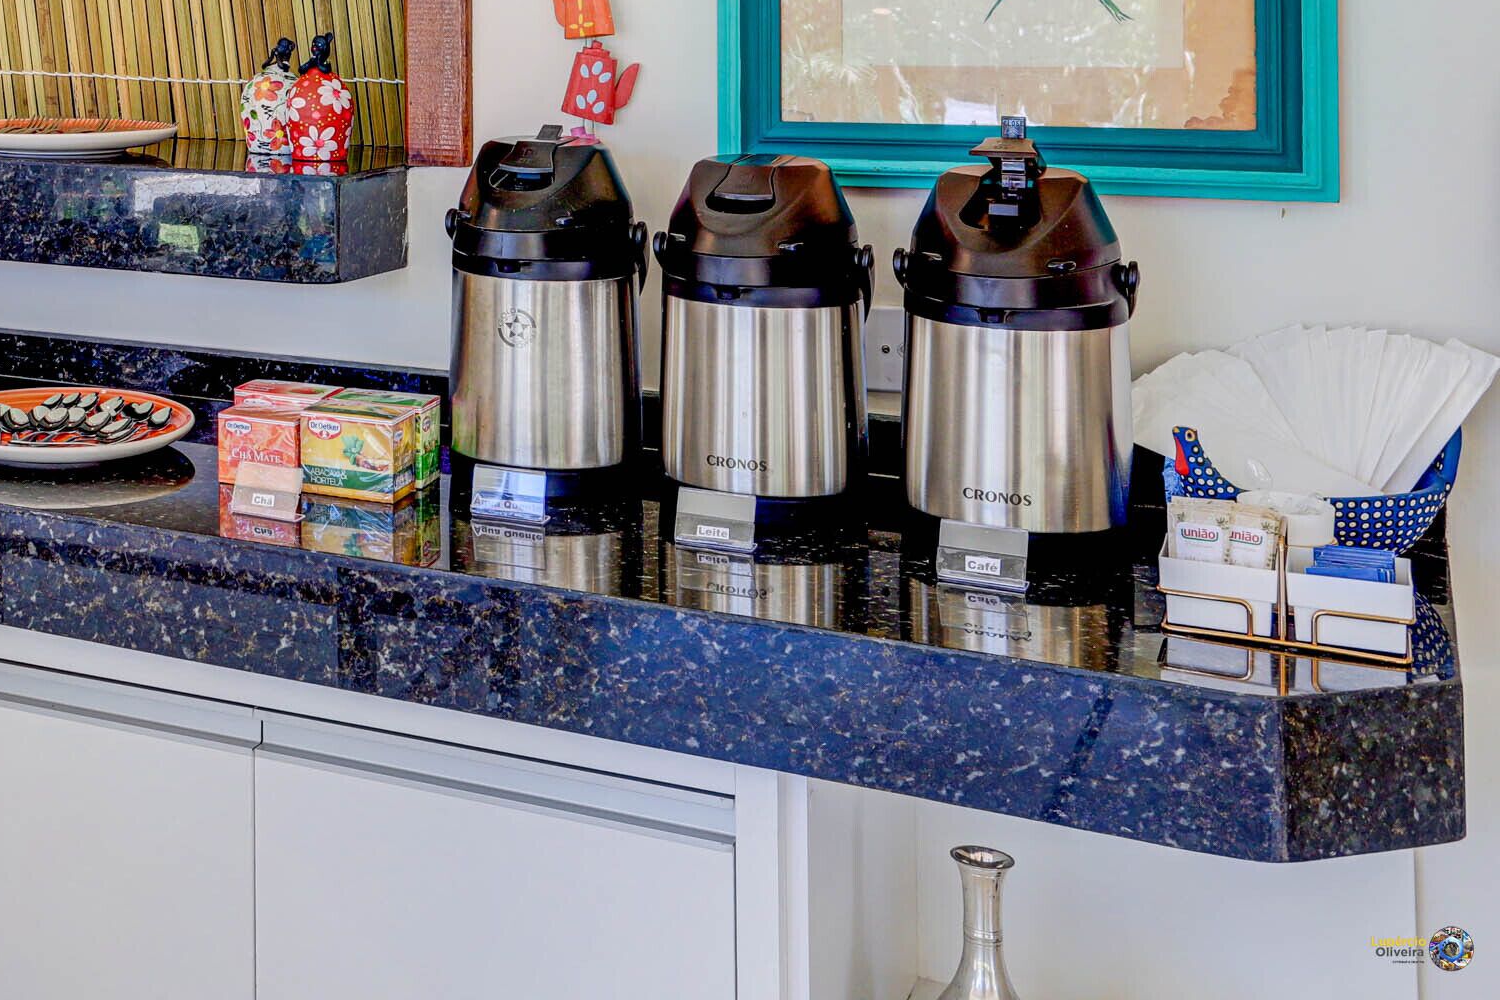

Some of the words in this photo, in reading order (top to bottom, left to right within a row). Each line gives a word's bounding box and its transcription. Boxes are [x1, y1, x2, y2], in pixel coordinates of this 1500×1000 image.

[706, 454, 768, 473] CRONOS
[253, 495, 273, 505] Chá
[962, 487, 1032, 507] CRONOS
[698, 526, 728, 538] Leite
[1183, 528, 1216, 539] união
[967, 560, 998, 573] Café
